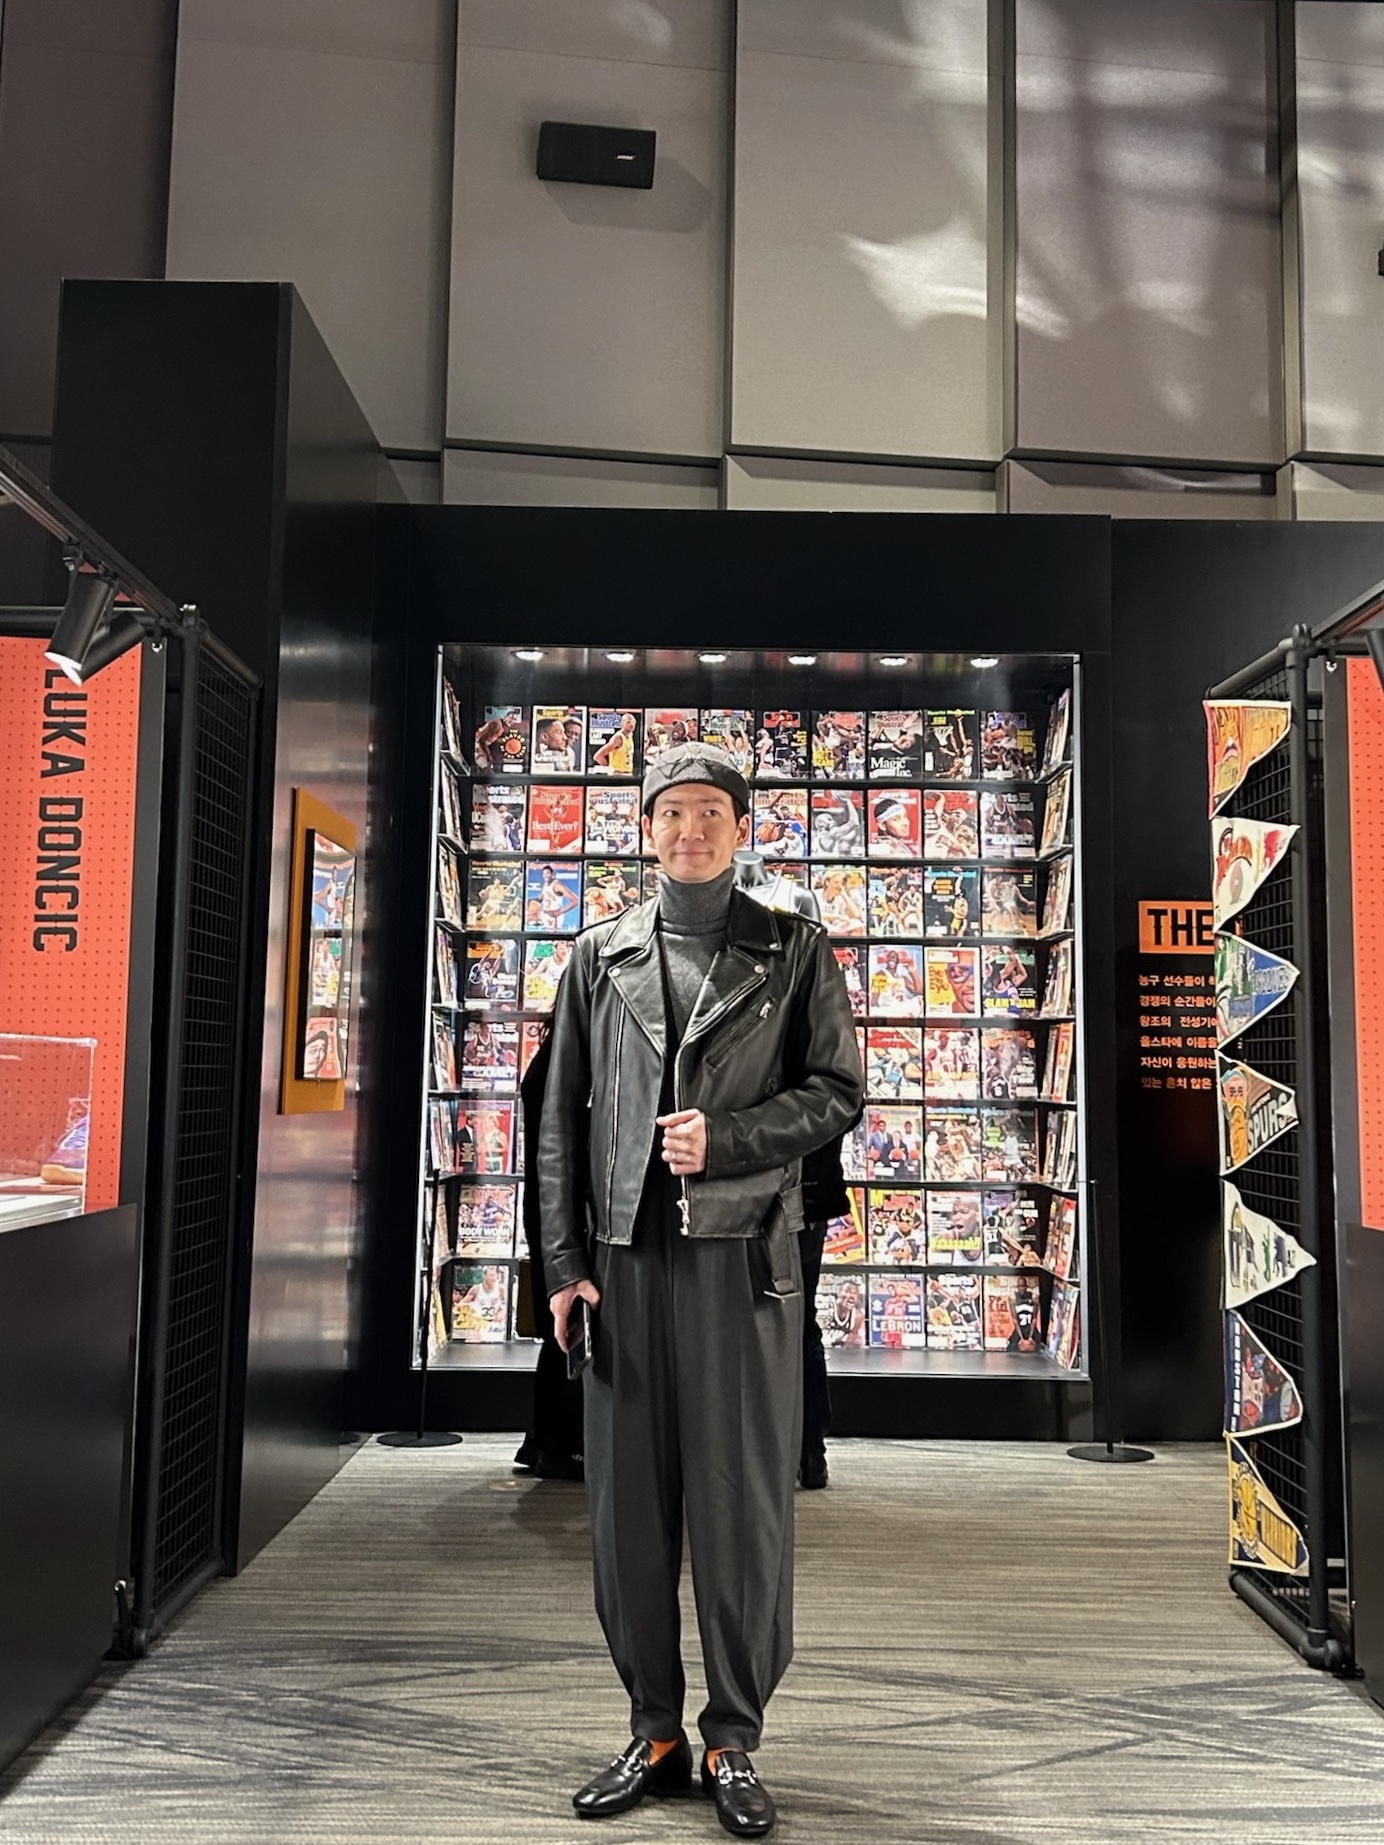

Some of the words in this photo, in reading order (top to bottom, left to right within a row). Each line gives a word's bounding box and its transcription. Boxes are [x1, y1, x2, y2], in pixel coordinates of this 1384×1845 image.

[41, 668, 88, 778] LUKA
[870, 757, 906, 769] Magic
[896, 769, 912, 777] Inc.
[532, 821, 551, 831] Best
[553, 821, 579, 831] Ever?
[33, 796, 84, 952] DONCIC
[1147, 909, 1215, 946] THE
[1139, 975, 1160, 987] 농구
[1163, 975, 1205, 987] 선수들이
[1140, 1016, 1172, 1027] 왕조의
[1141, 1057, 1173, 1068] 자신이
[1247, 1092, 1288, 1154] SPURS
[481, 1306, 497, 1317] 33
